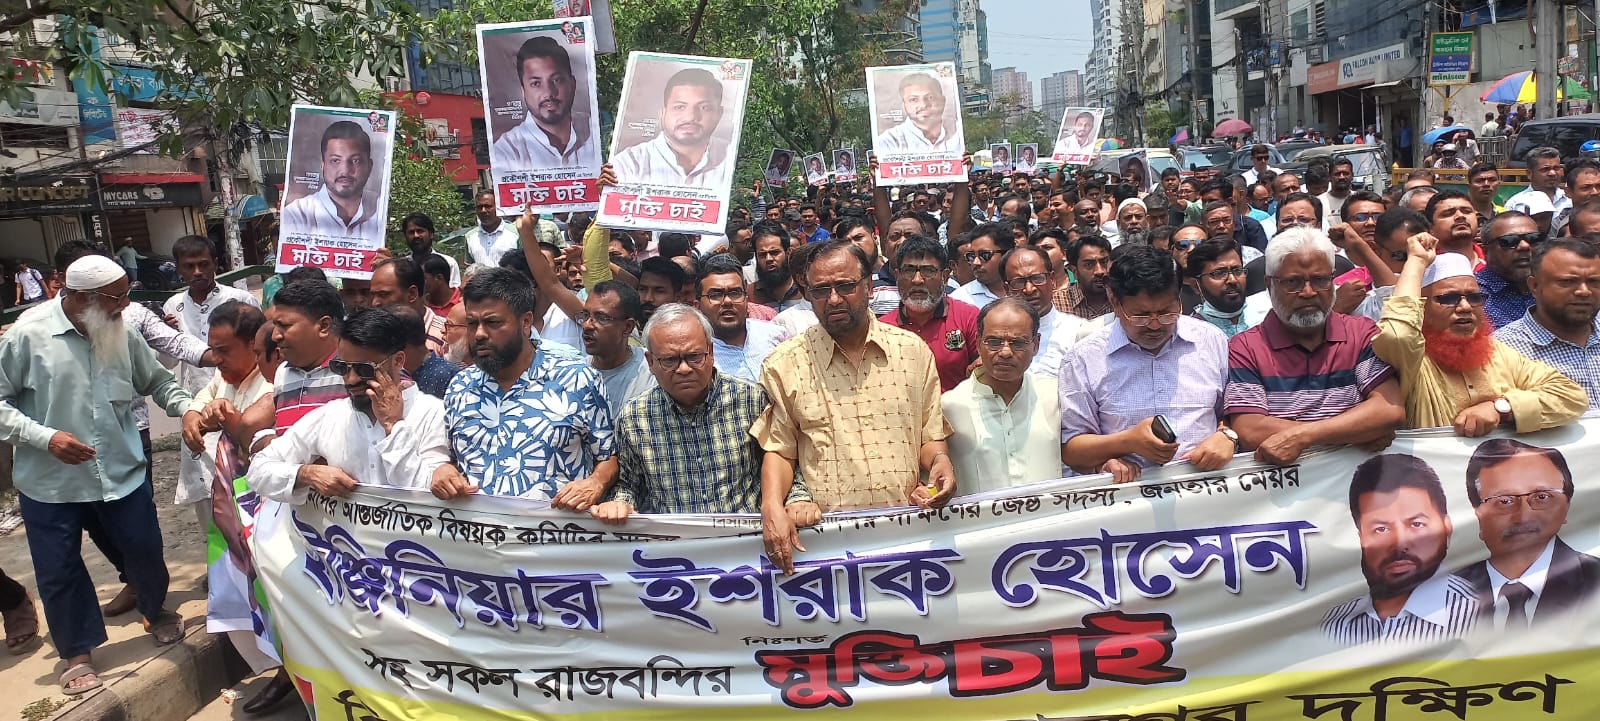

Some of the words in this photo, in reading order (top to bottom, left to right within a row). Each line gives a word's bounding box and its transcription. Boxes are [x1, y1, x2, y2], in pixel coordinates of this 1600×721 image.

[1382, 49, 1400, 61] LIMITED
[1432, 73, 1466, 81] minister
[890, 162, 922, 183] মুক্তি
[927, 161, 953, 176] চাই
[104, 191, 139, 201] MYCARS
[510, 181, 549, 212] মুক্তি
[554, 181, 586, 201] চাই
[619, 196, 665, 225] মুক্তি
[669, 201, 707, 220] চাই
[333, 249, 365, 268] চাই
[1140, 474, 1230, 499] জনতার
[1239, 464, 1301, 491] মেয়র
[342, 501, 432, 536] আন্তর্জাতিক
[437, 508, 508, 546] বিষয়ক
[292, 508, 612, 632] ইঞ্জিনিয়ার
[627, 549, 965, 632] ইশরাক
[990, 521, 1320, 608] হোসেন
[361, 648, 414, 691] সহ
[421, 660, 523, 698] সকল
[531, 655, 736, 700] রাজবন্দির
[755, 630, 951, 708] মুক্তি
[948, 610, 1188, 698] চাই
[1288, 674, 1576, 721] দক্ষিণ
